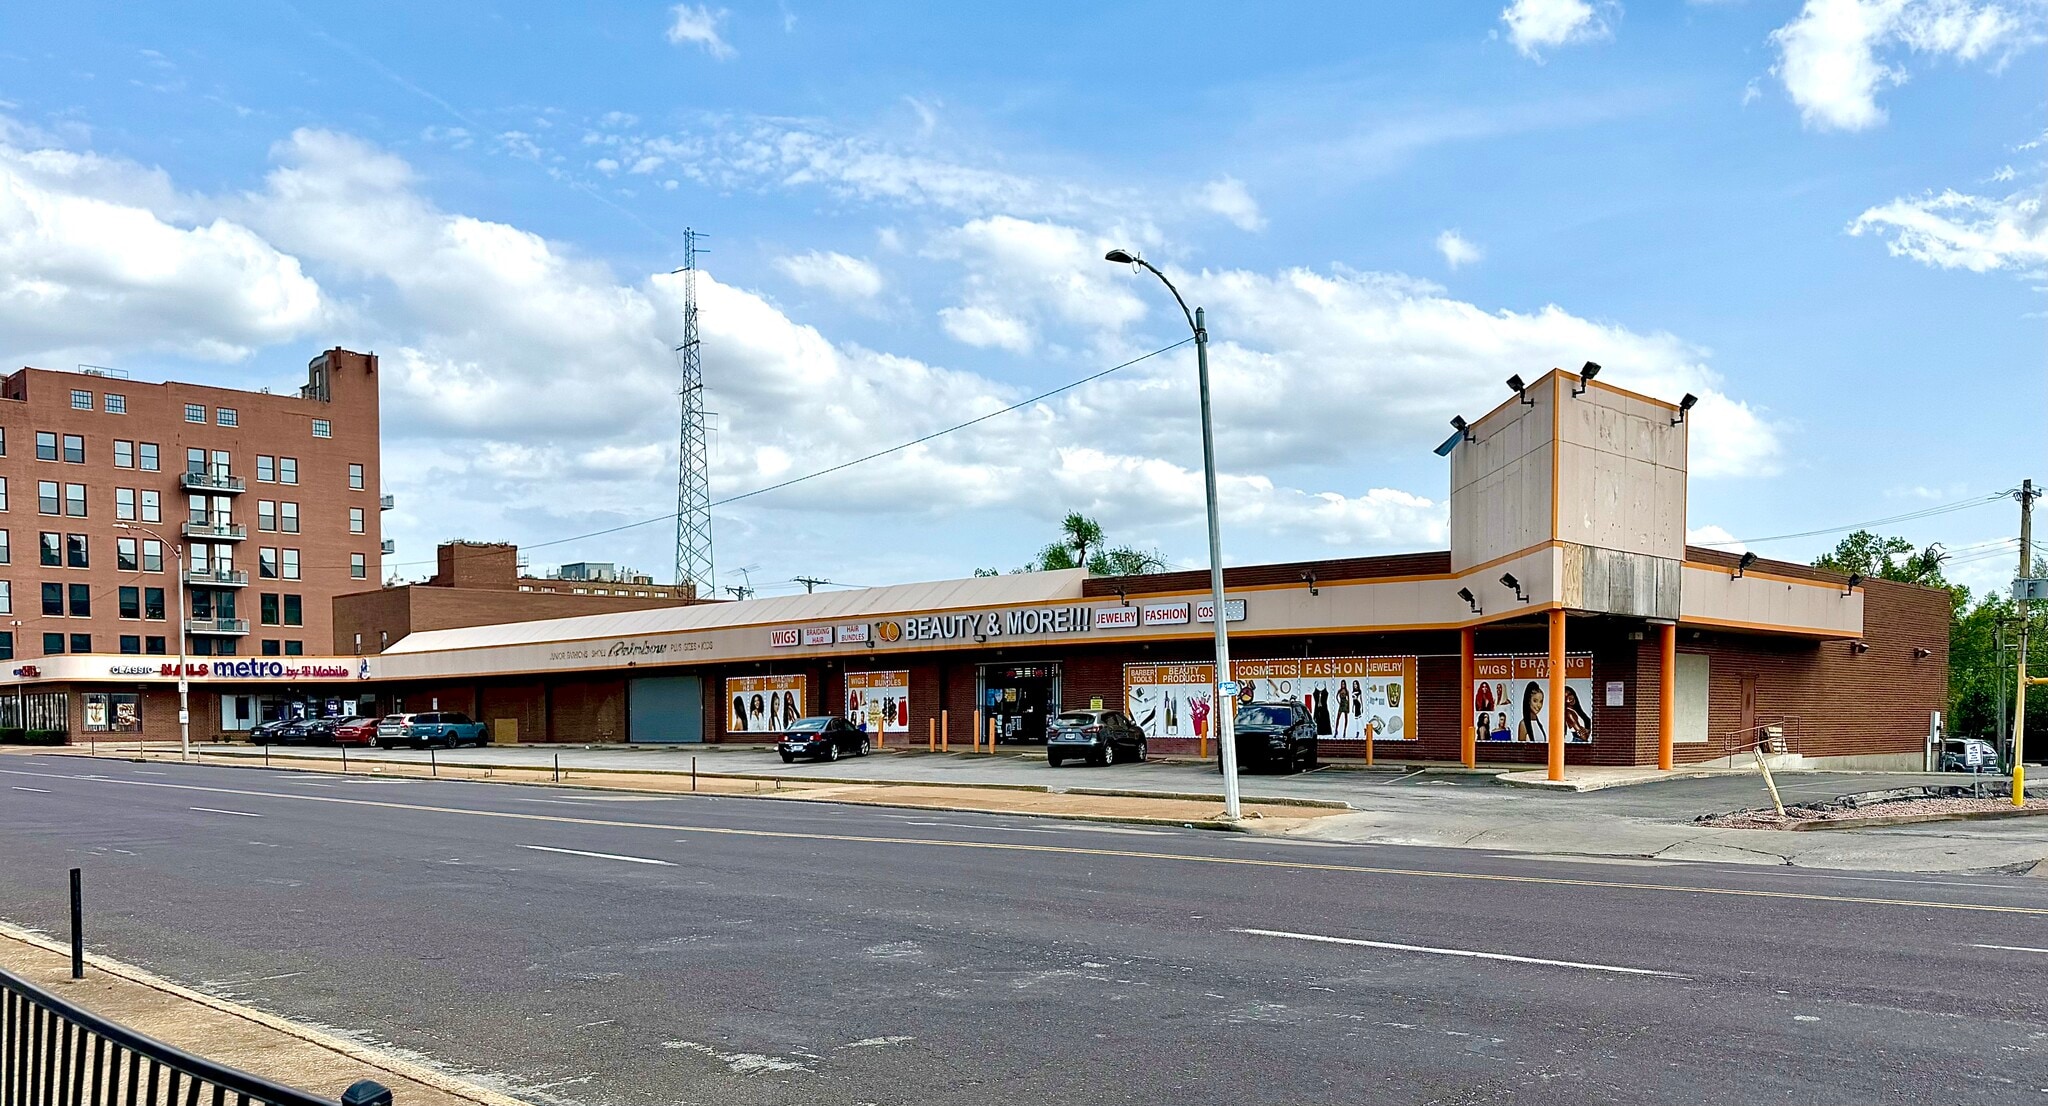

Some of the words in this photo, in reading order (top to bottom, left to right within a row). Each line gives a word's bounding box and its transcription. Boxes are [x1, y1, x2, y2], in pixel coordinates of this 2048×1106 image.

[1096, 611, 1136, 625] JEWELRY
[1145, 608, 1187, 621] FASHION
[846, 625, 860, 633] HAIR
[905, 614, 982, 640] BEAUTY
[986, 612, 1001, 636] &
[1006, 608, 1090, 635] MORE!!!
[806, 627, 830, 636] BRAIDING
[772, 630, 797, 645] WIGS
[841, 633, 865, 641] BUNDLES
[608, 640, 667, 657] Rainbow
[213, 658, 283, 677] metro
[286, 666, 299, 679] by
[1369, 662, 1402, 672] JEWELRY
[1520, 658, 1584, 669] BRAING
[111, 665, 154, 675] CLASSIC
[1168, 666, 1199, 675] BEAUTY
[1238, 664, 1297, 676] COSMETICS
[1478, 665, 1508, 675] WIGS
[850, 677, 865, 685] WIGS
[874, 679, 902, 687] BUNDLES
[1162, 674, 1206, 683] PRODUCTS
